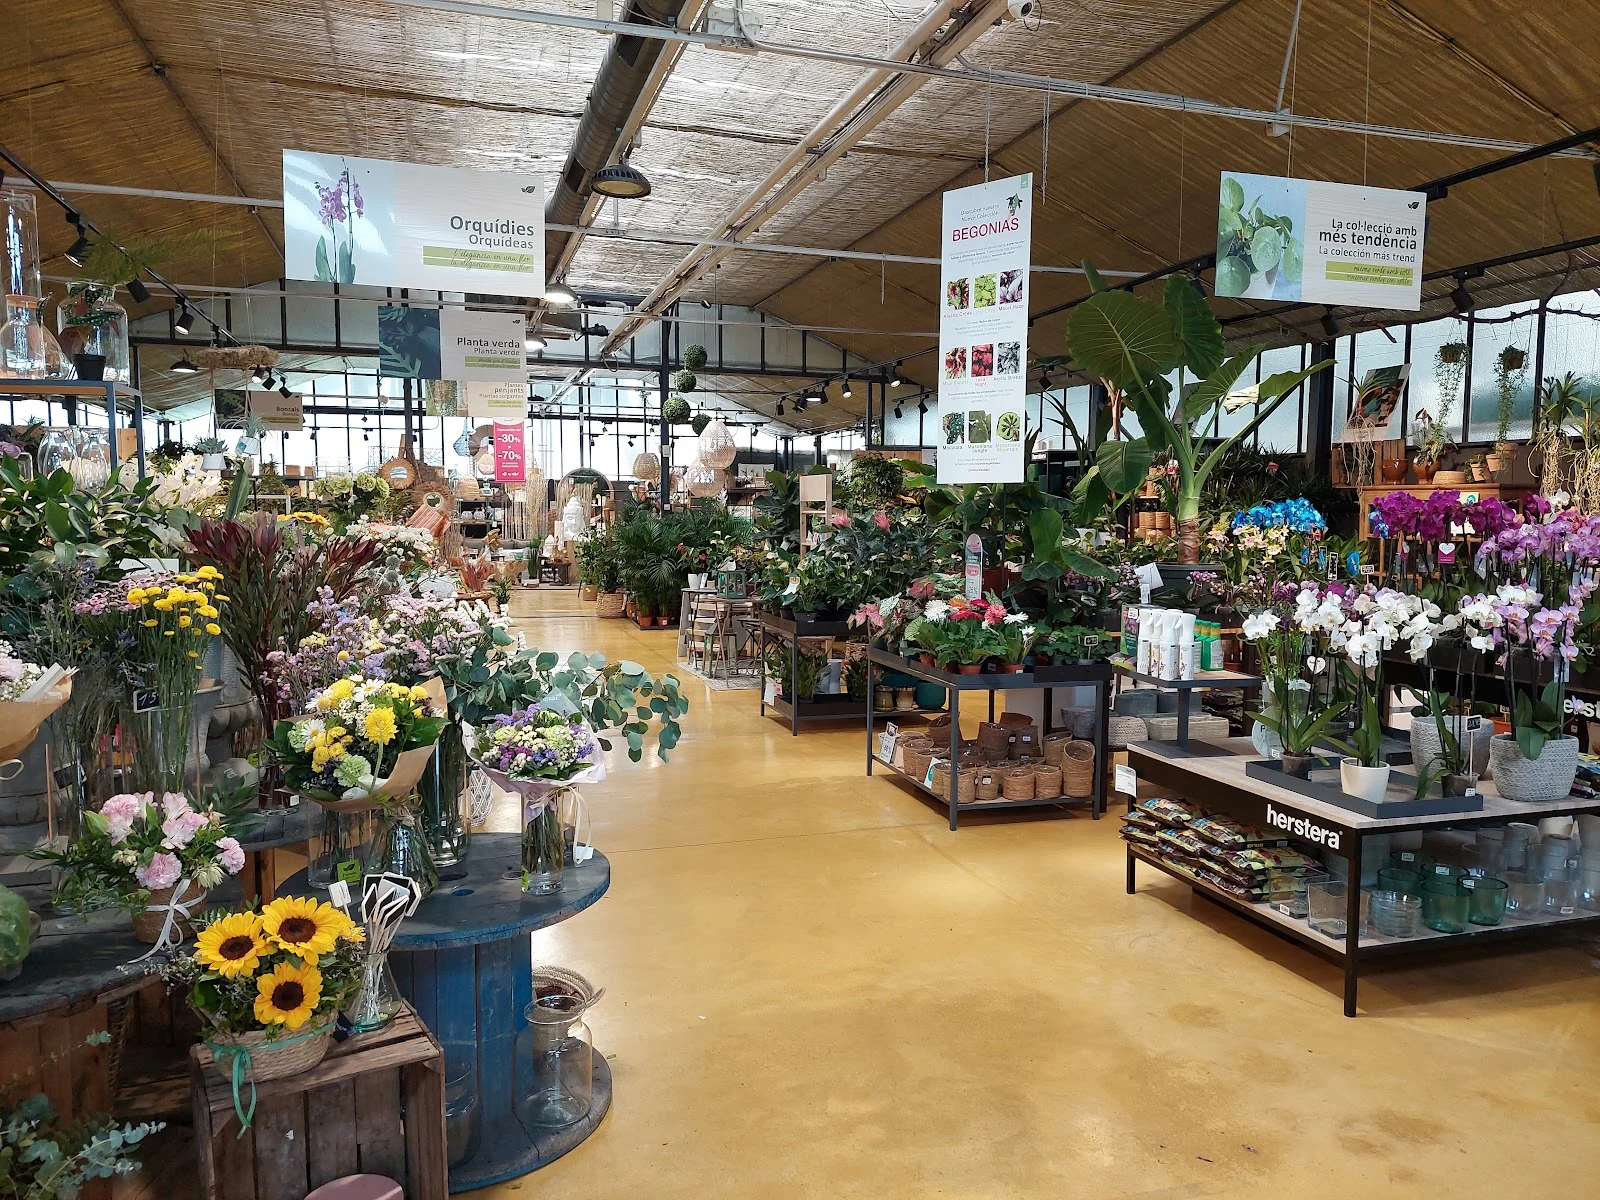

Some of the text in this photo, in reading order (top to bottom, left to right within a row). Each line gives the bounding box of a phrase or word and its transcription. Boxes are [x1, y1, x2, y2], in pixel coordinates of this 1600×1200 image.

[450, 216, 534, 236] Orquídies
[952, 218, 1019, 242] BEGONIAS
[1332, 218, 1417, 236] La col·lecció amb
[468, 234, 534, 249] Orquídeas
[1319, 228, 1417, 250] més tendència
[1319, 246, 1416, 263] La colección más trend
[457, 337, 520, 348] Planta verda
[497, 433, 521, 444] -30%
[498, 450, 522, 460] -70%
[1266, 804, 1340, 850] herstera
